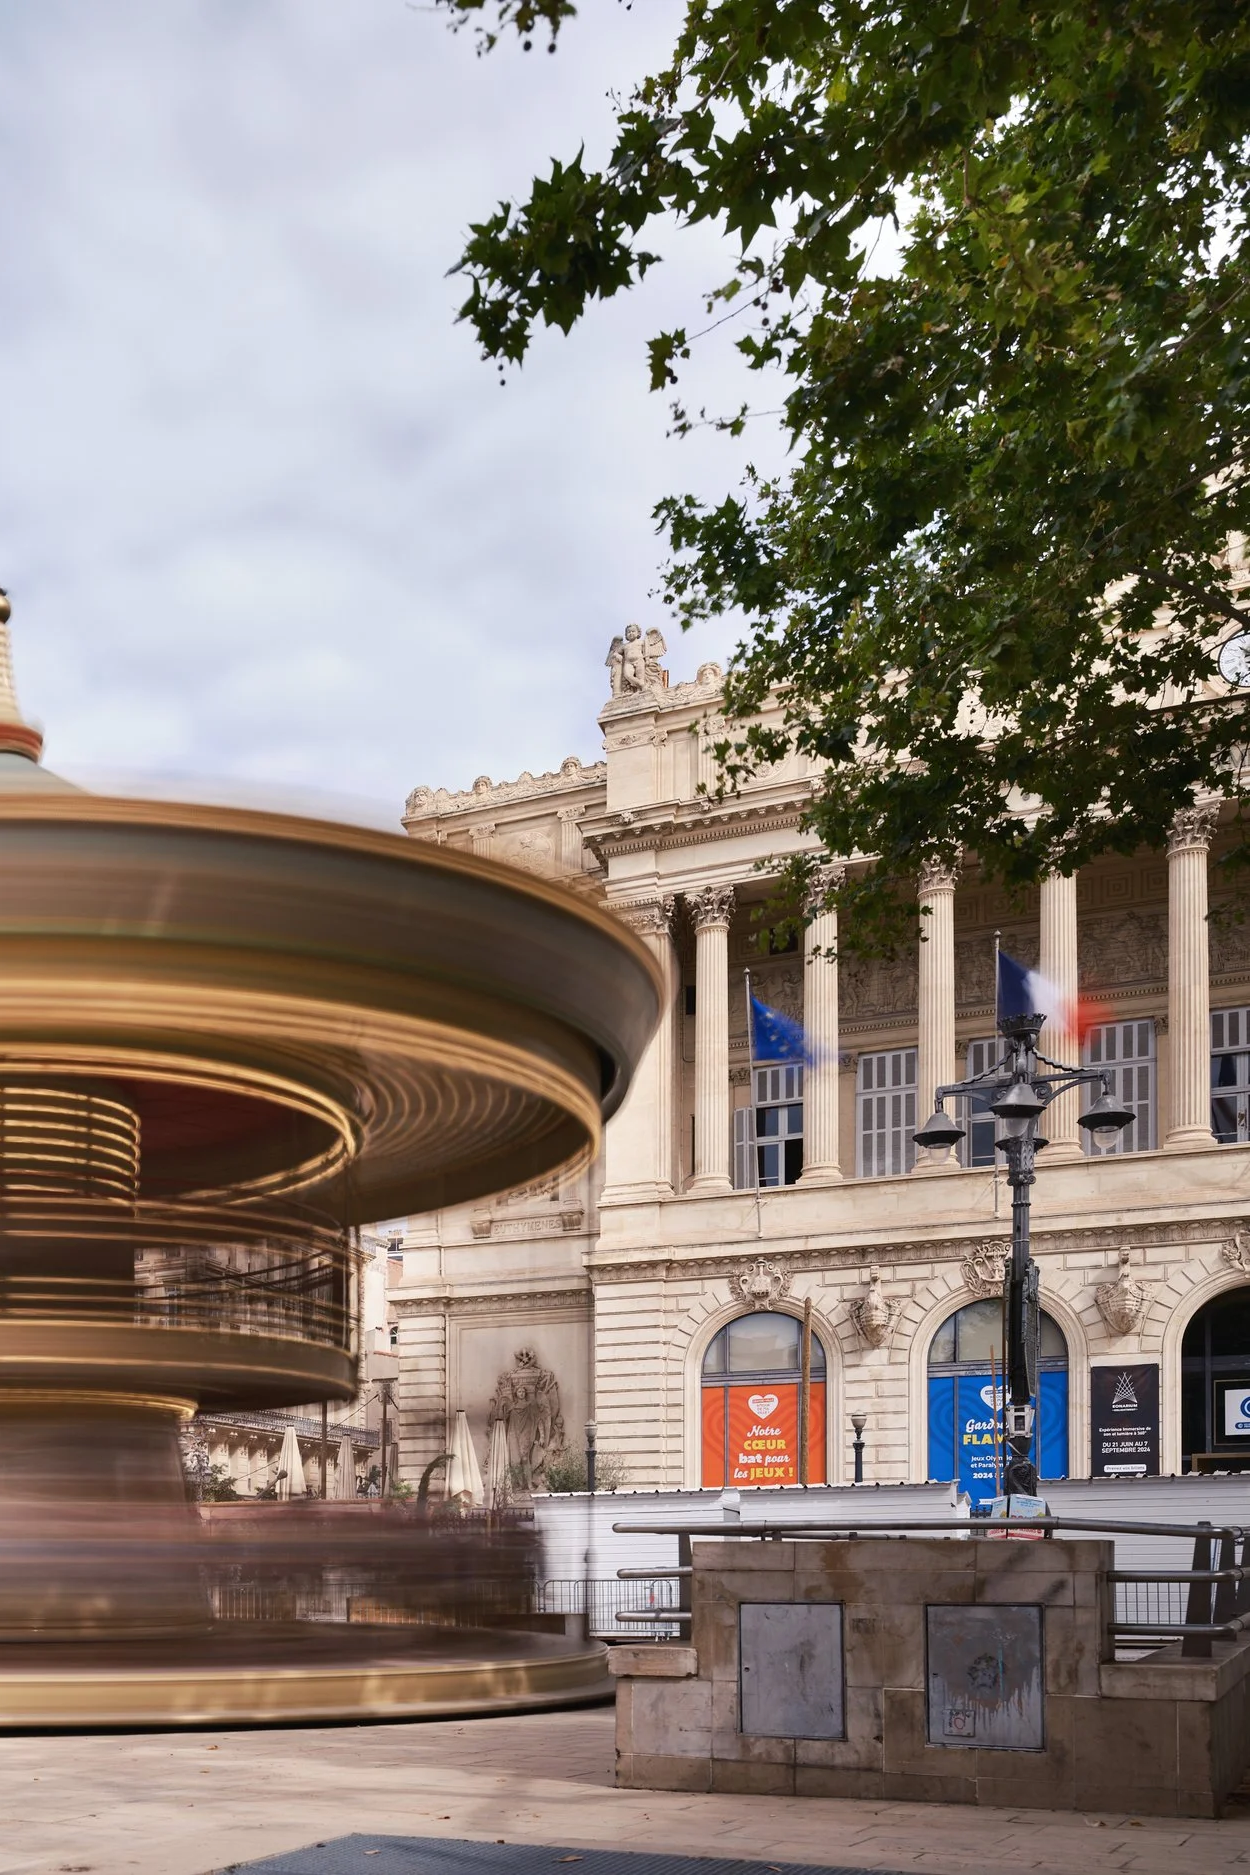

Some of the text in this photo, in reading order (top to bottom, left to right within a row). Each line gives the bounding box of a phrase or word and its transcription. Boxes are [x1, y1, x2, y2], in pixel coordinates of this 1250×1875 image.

[747, 1425, 781, 1437] Notre
[743, 1440, 786, 1450] CŒUR
[739, 1453, 791, 1466] bat pour
[734, 1467, 793, 1480] les JEUX !
